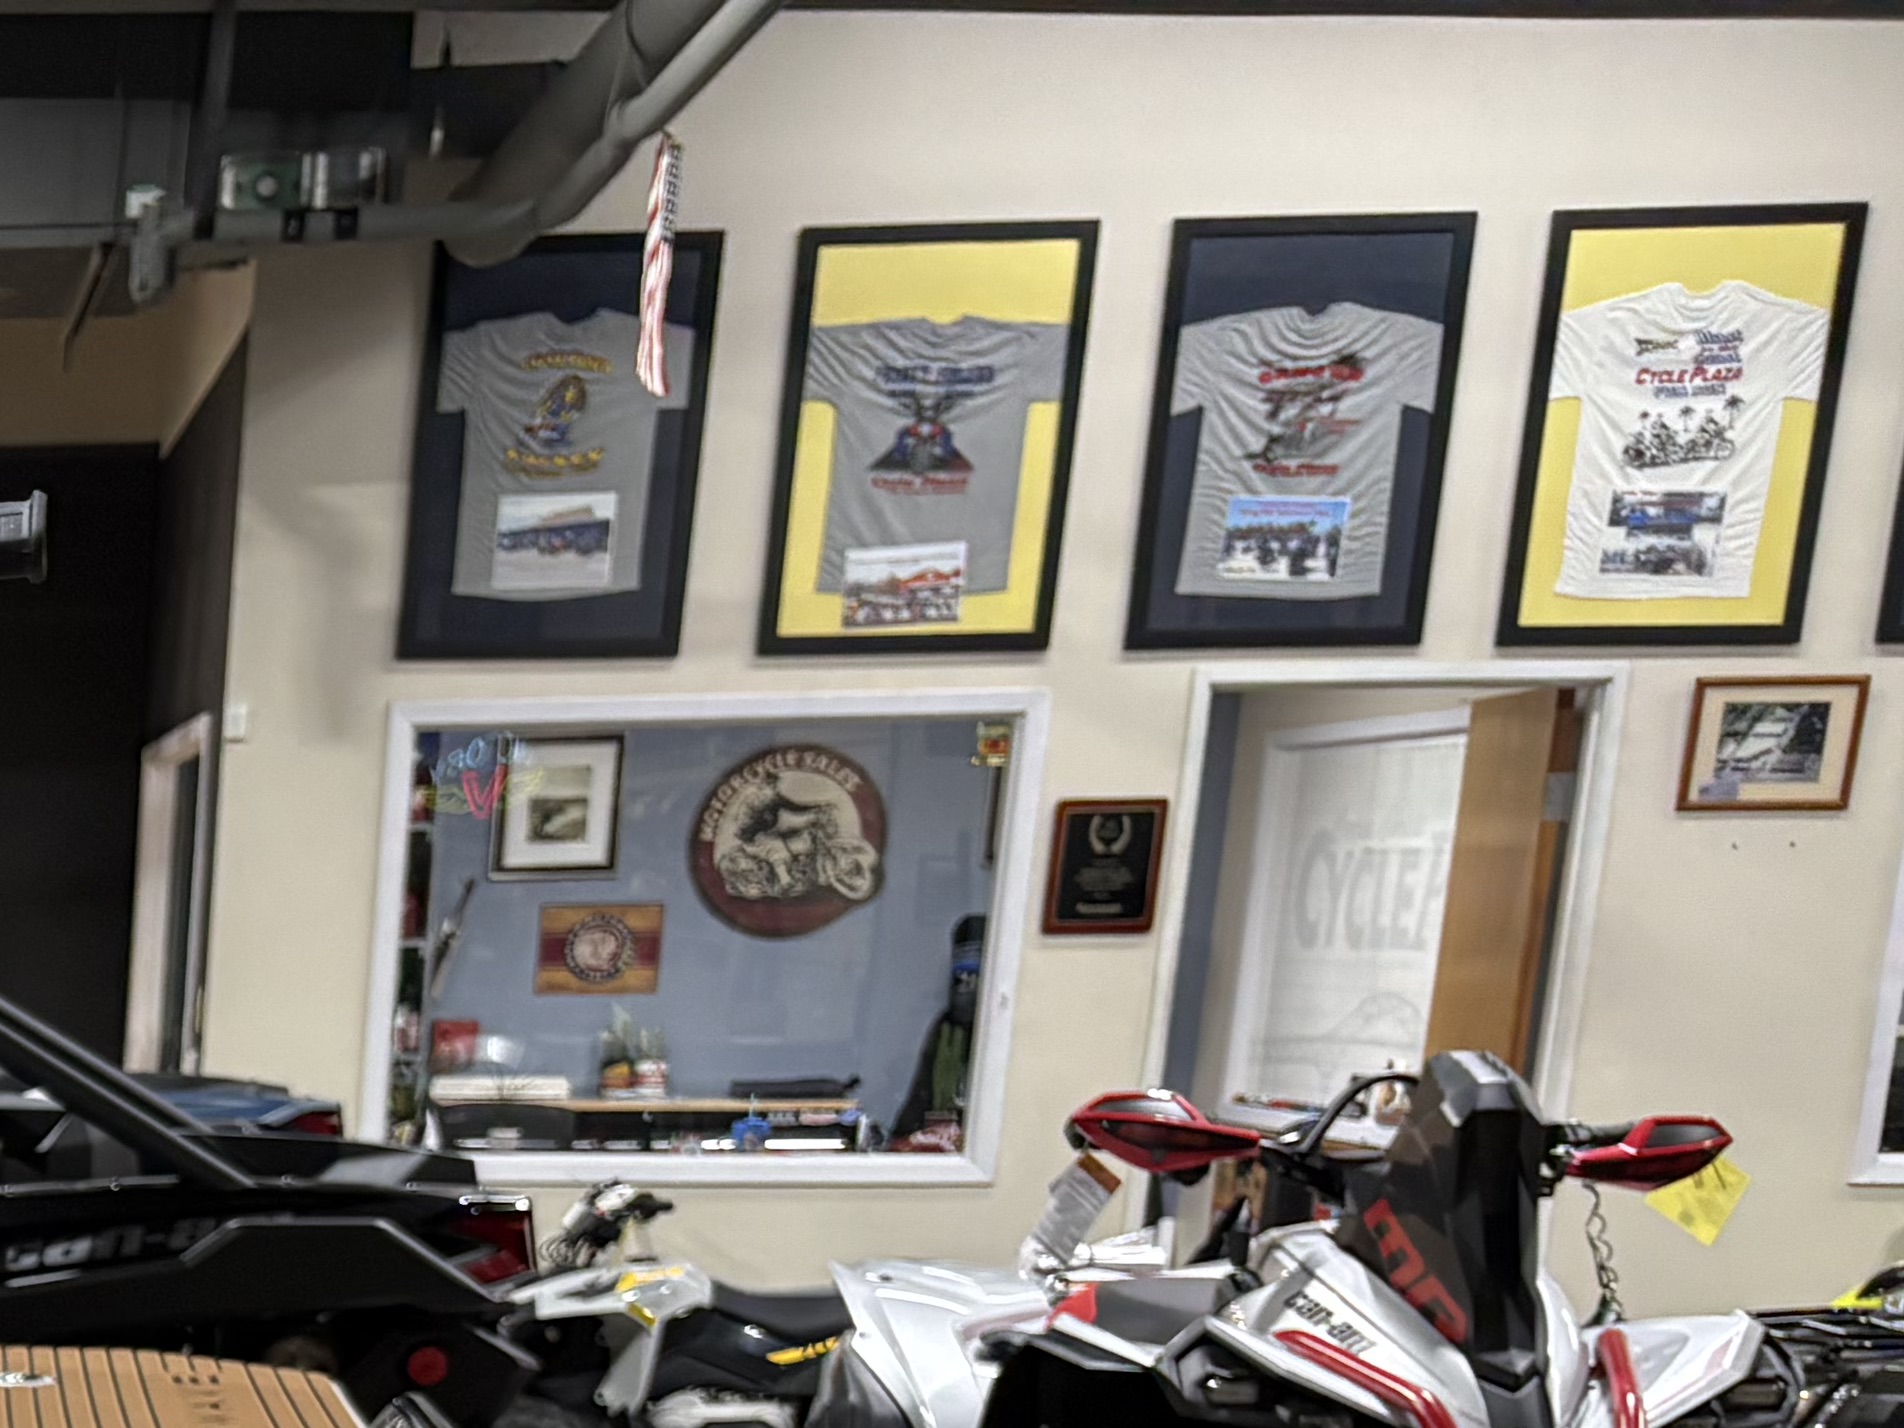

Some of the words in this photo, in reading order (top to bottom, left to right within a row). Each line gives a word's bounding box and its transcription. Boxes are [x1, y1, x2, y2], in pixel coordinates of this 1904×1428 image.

[699, 749, 798, 842] MOTORCYCLE
[801, 751, 864, 793] SALES
[4, 1217, 217, 1272] can-a
[1284, 1289, 1377, 1356] can-am
